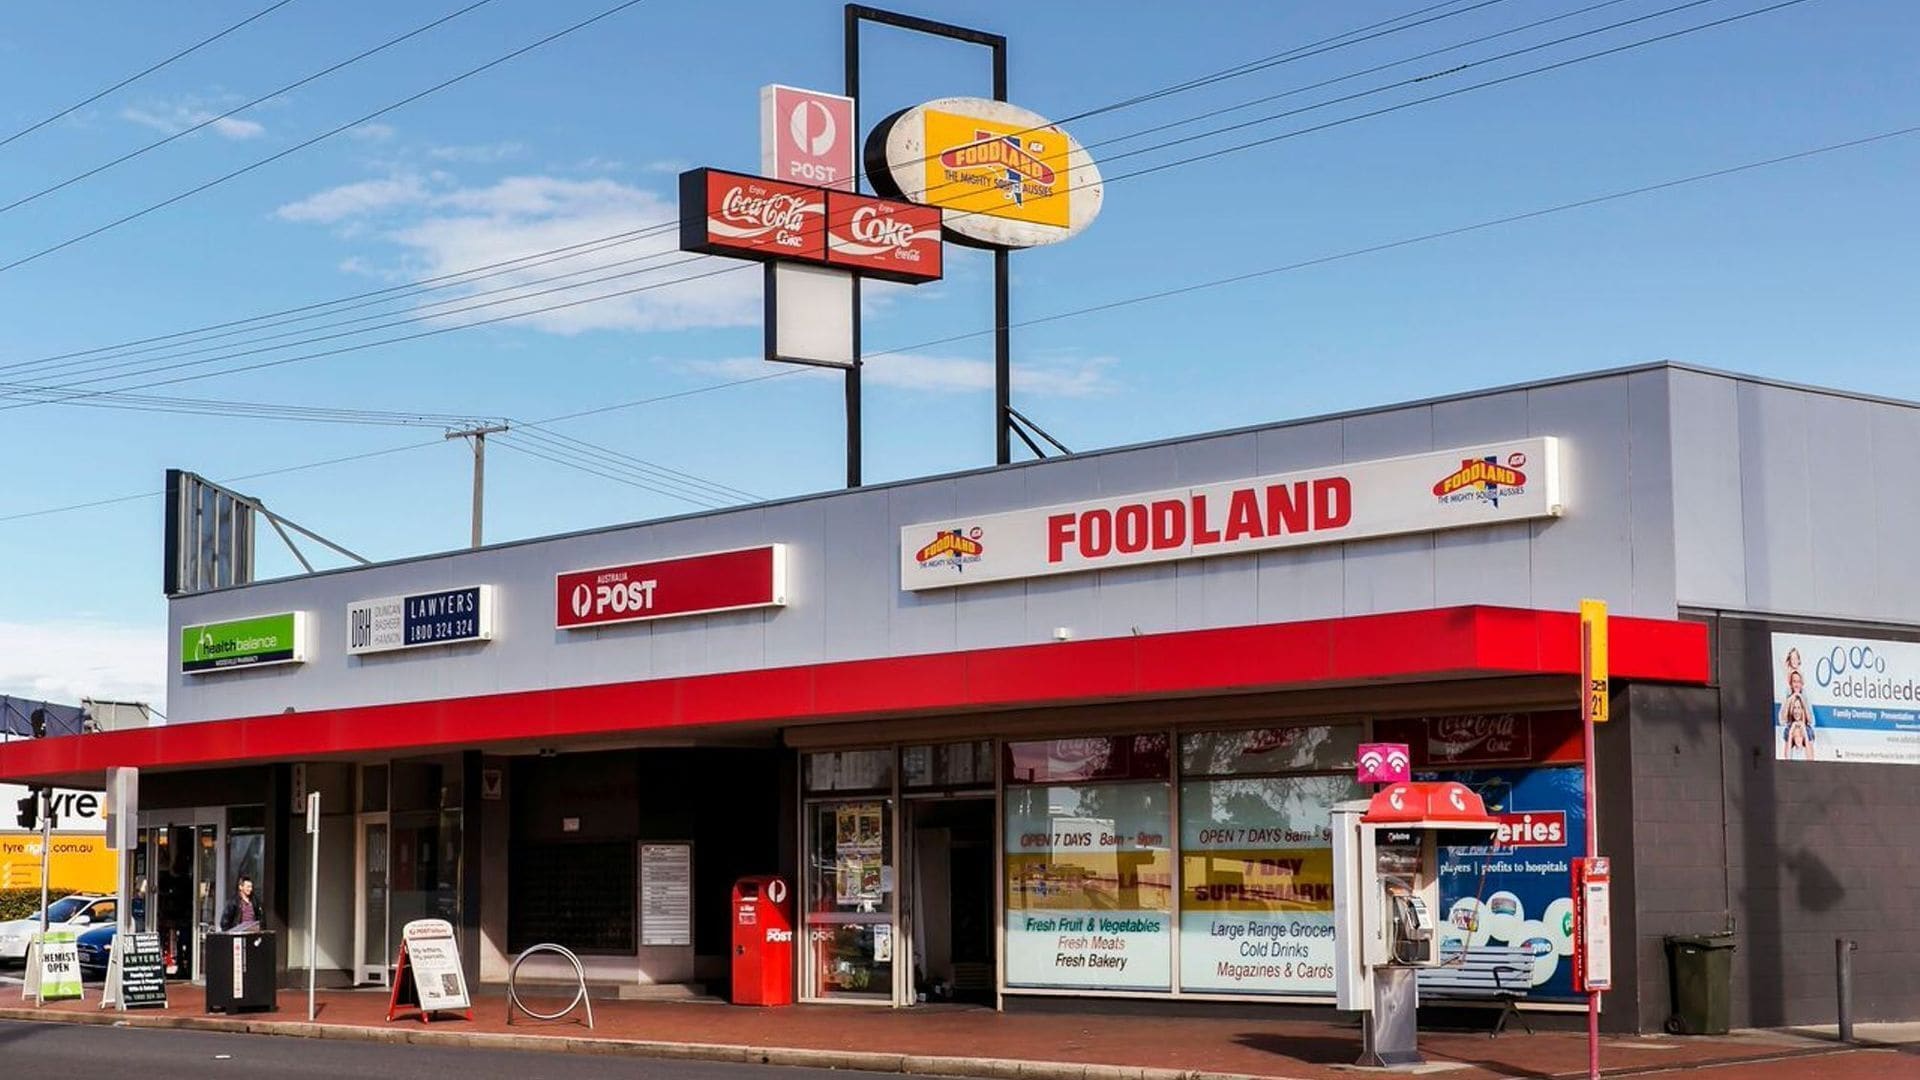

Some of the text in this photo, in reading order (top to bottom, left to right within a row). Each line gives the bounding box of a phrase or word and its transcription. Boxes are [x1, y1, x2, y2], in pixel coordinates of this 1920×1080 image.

[955, 139, 1044, 178] FOODLAND
[790, 162, 837, 183] POST
[850, 206, 915, 248] Coke
[1443, 461, 1516, 494] FOODLAND
[1048, 475, 1352, 564] FOODLAND
[924, 534, 976, 560] FOODLAND
[597, 572, 628, 584] AUSTRALIA
[411, 592, 474, 619] LAWYERS
[597, 580, 657, 614] POST
[352, 608, 371, 648] DBH
[411, 619, 473, 641] 1800 324 324
[51, 793, 98, 819] yre
[1199, 829, 1234, 844] OPEN
[1237, 829, 1246, 843] 7
[1247, 827, 1282, 844] DAYS
[1284, 828, 1310, 844] 8am
[1496, 814, 1562, 842] eries
[1020, 833, 1052, 848] OPEN
[1053, 833, 1061, 846] 7
[1063, 832, 1092, 847] DAYS
[1099, 832, 1124, 846] 8am
[1137, 831, 1163, 850] 9pm
[1257, 858, 1304, 876] DAY
[1440, 861, 1471, 875] players
[1514, 862, 1524, 873] to
[1525, 860, 1568, 875] hospitals
[1195, 884, 1334, 902] SUPERMARK
[1026, 917, 1160, 935] Fresh Fruit & Vegetables
[1210, 920, 1246, 941] Large
[1247, 921, 1287, 941] Range
[766, 932, 792, 943] POST
[1057, 935, 1126, 950] Fresh Meats
[42, 951, 76, 964] HEMIST
[124, 953, 161, 964] AWYERS
[1240, 941, 1309, 958] Cold Drinks
[47, 963, 70, 974] OPEN
[1055, 953, 1128, 972] Fresh Bakery
[1217, 962, 1334, 981] Magazines & Cards
